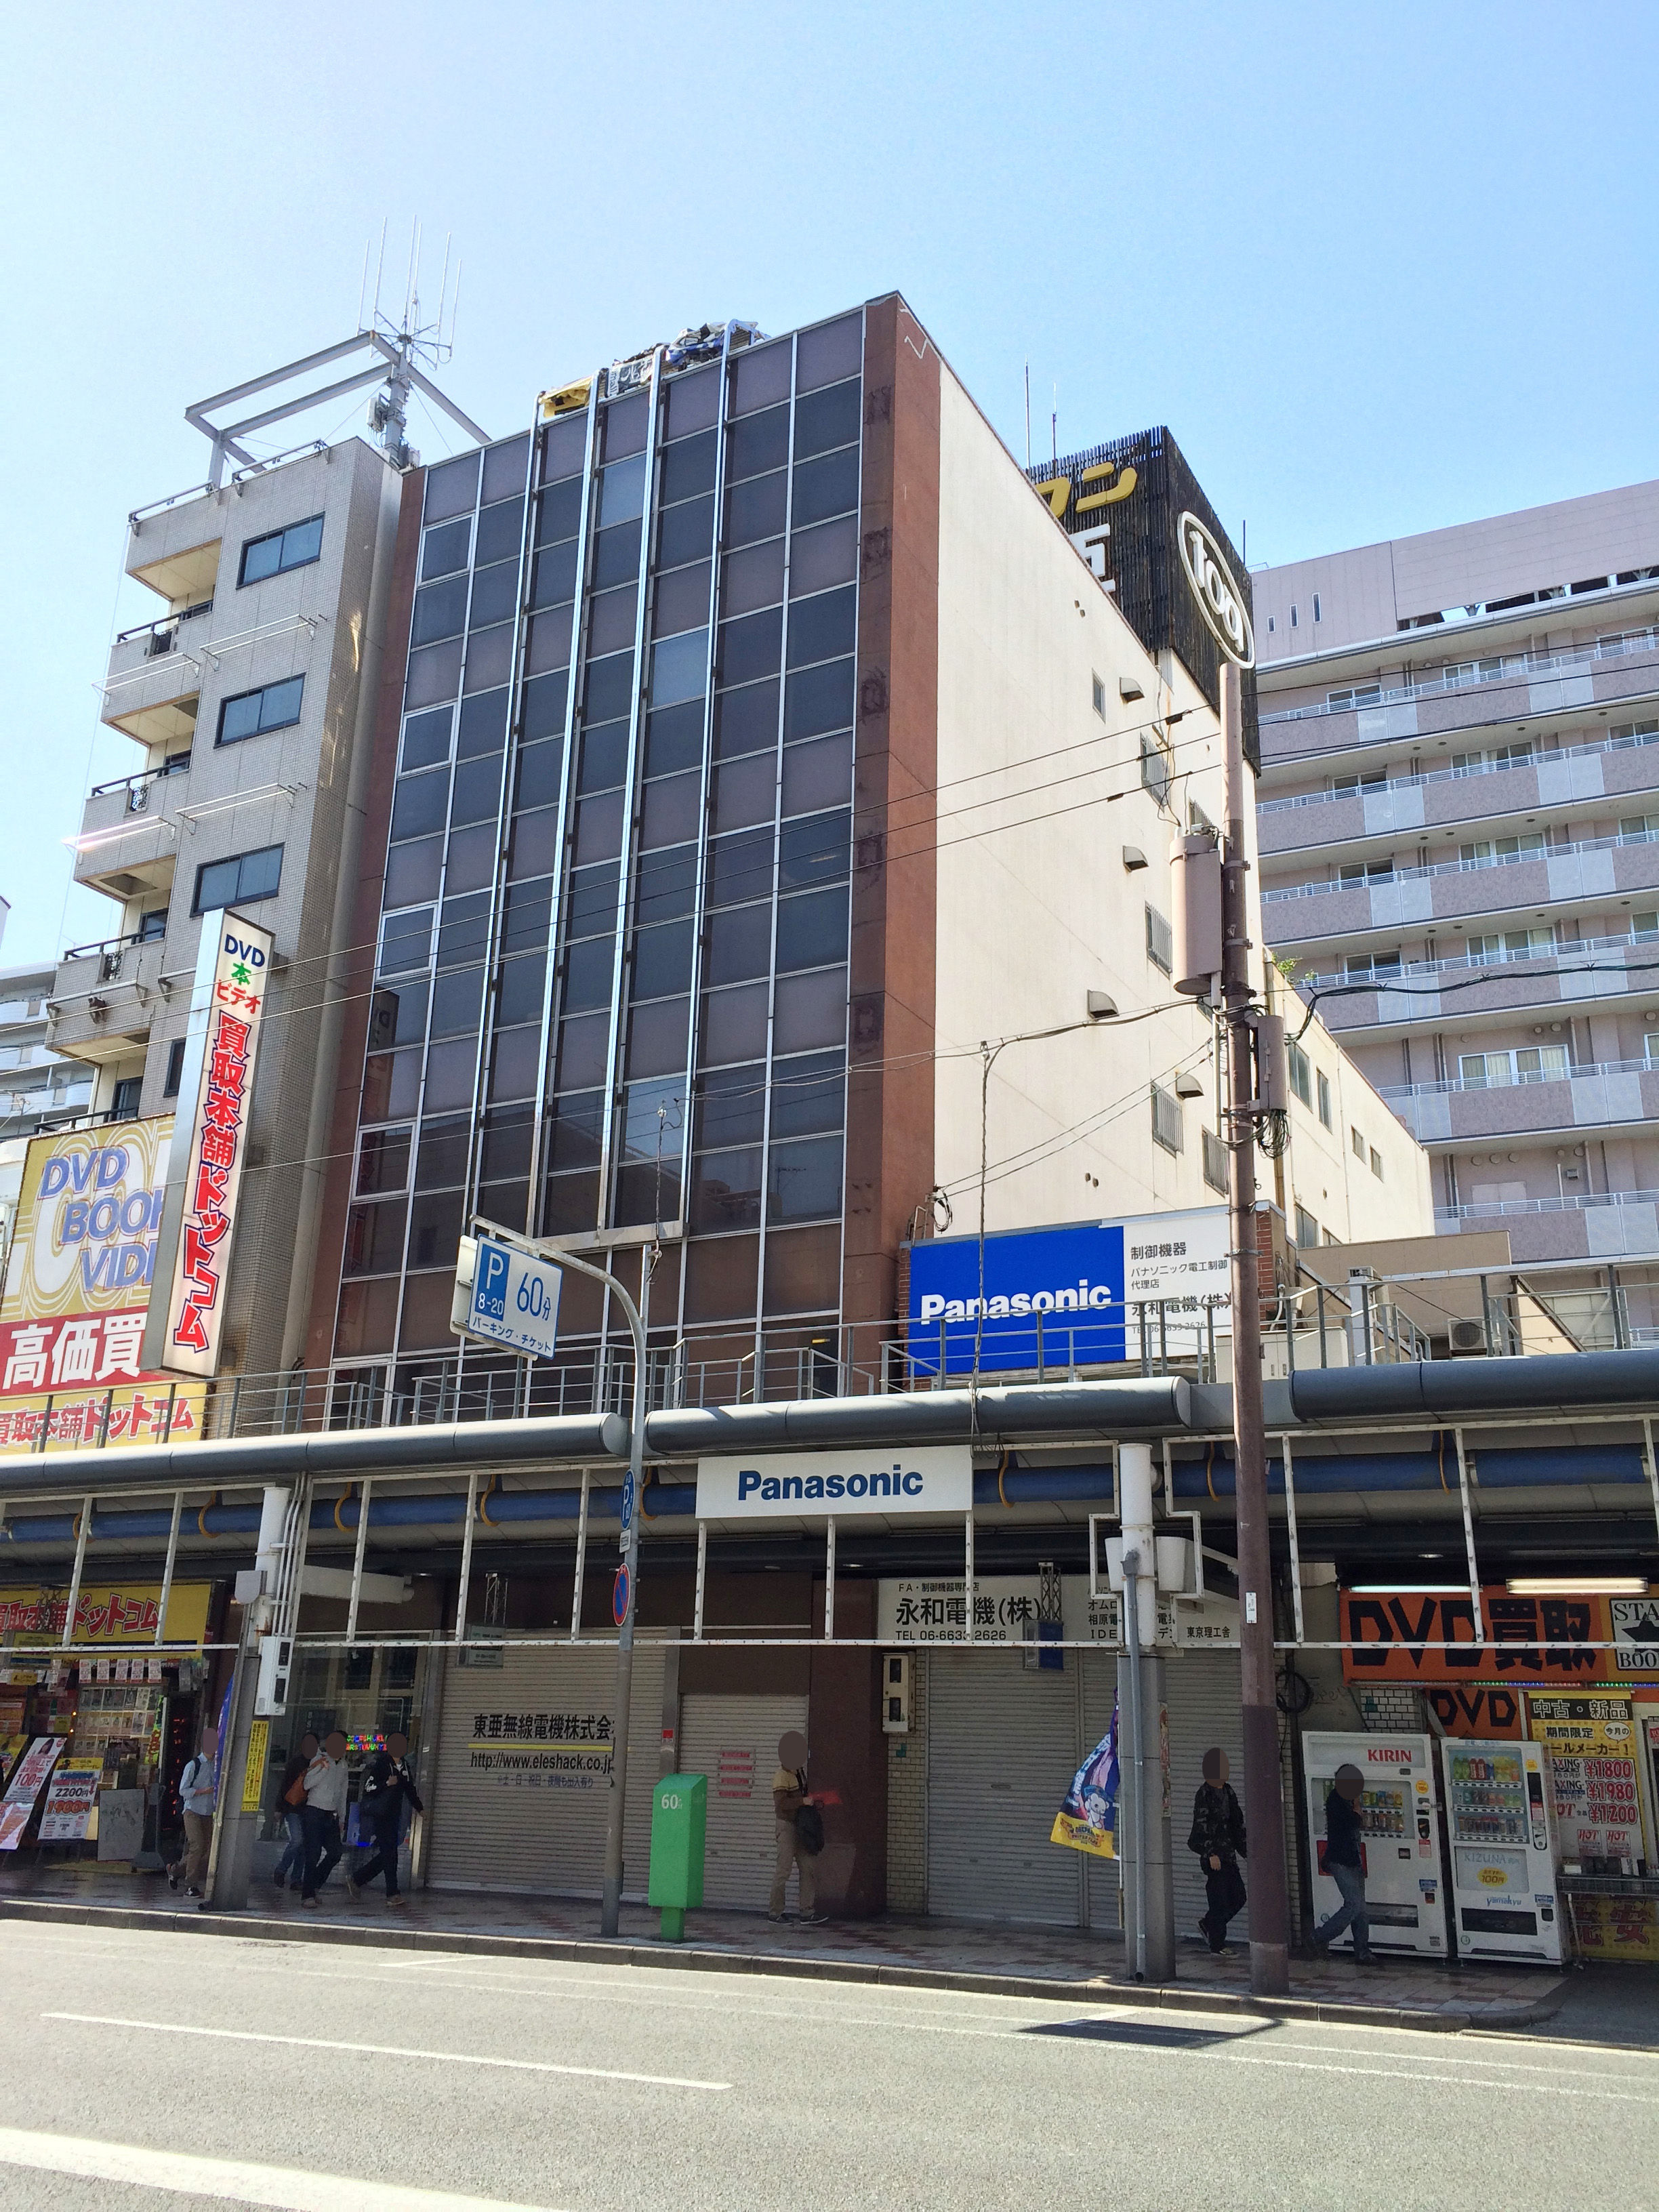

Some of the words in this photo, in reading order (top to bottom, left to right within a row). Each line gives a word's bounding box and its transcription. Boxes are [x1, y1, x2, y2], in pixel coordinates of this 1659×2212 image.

[224, 934, 265, 967] DVD
[231, 962, 251, 985] 本
[217, 979, 260, 1014] ビデオ
[39, 1145, 128, 1199] DVD
[174, 1009, 251, 1353] 買取本舗ドットコム
[1130, 1242, 1186, 1260] 制御機器
[487, 1252, 504, 1289] P
[1131, 1279, 1160, 1291] 代理店
[478, 1293, 504, 1315] 8-20
[517, 1272, 551, 1321] 60分
[920, 1279, 1111, 1326] Panasonic
[738, 1465, 924, 1500] Panasonic
[897, 1596, 1041, 1626] 永和電機(株)
[896, 1631, 916, 1640] TEL
[1349, 1597, 1597, 1671] DVD買取
[1431, 1689, 1517, 1727] DVD
[1533, 1700, 1629, 1719] 中古・新品
[473, 1713, 614, 1740] 東亜無線電機株式会
[1547, 1727, 1594, 1738] 期間限定
[1606, 1727, 1629, 1736] 今月の
[1368, 1749, 1412, 1762] KIRIN
[16, 1773, 44, 1787] 100円
[1584, 1759, 1633, 1780] ¥1800
[1586, 1781, 1635, 1802] ¥1980
[1588, 1803, 1638, 1824] ¥1200
[1579, 1830, 1598, 1841] HOT
[1607, 1830, 1626, 1842] HOT
[1464, 1853, 1506, 1864] KIZUNA
[1481, 1875, 1504, 1883] 100円
[1487, 1895, 1522, 1906] yamakyu
